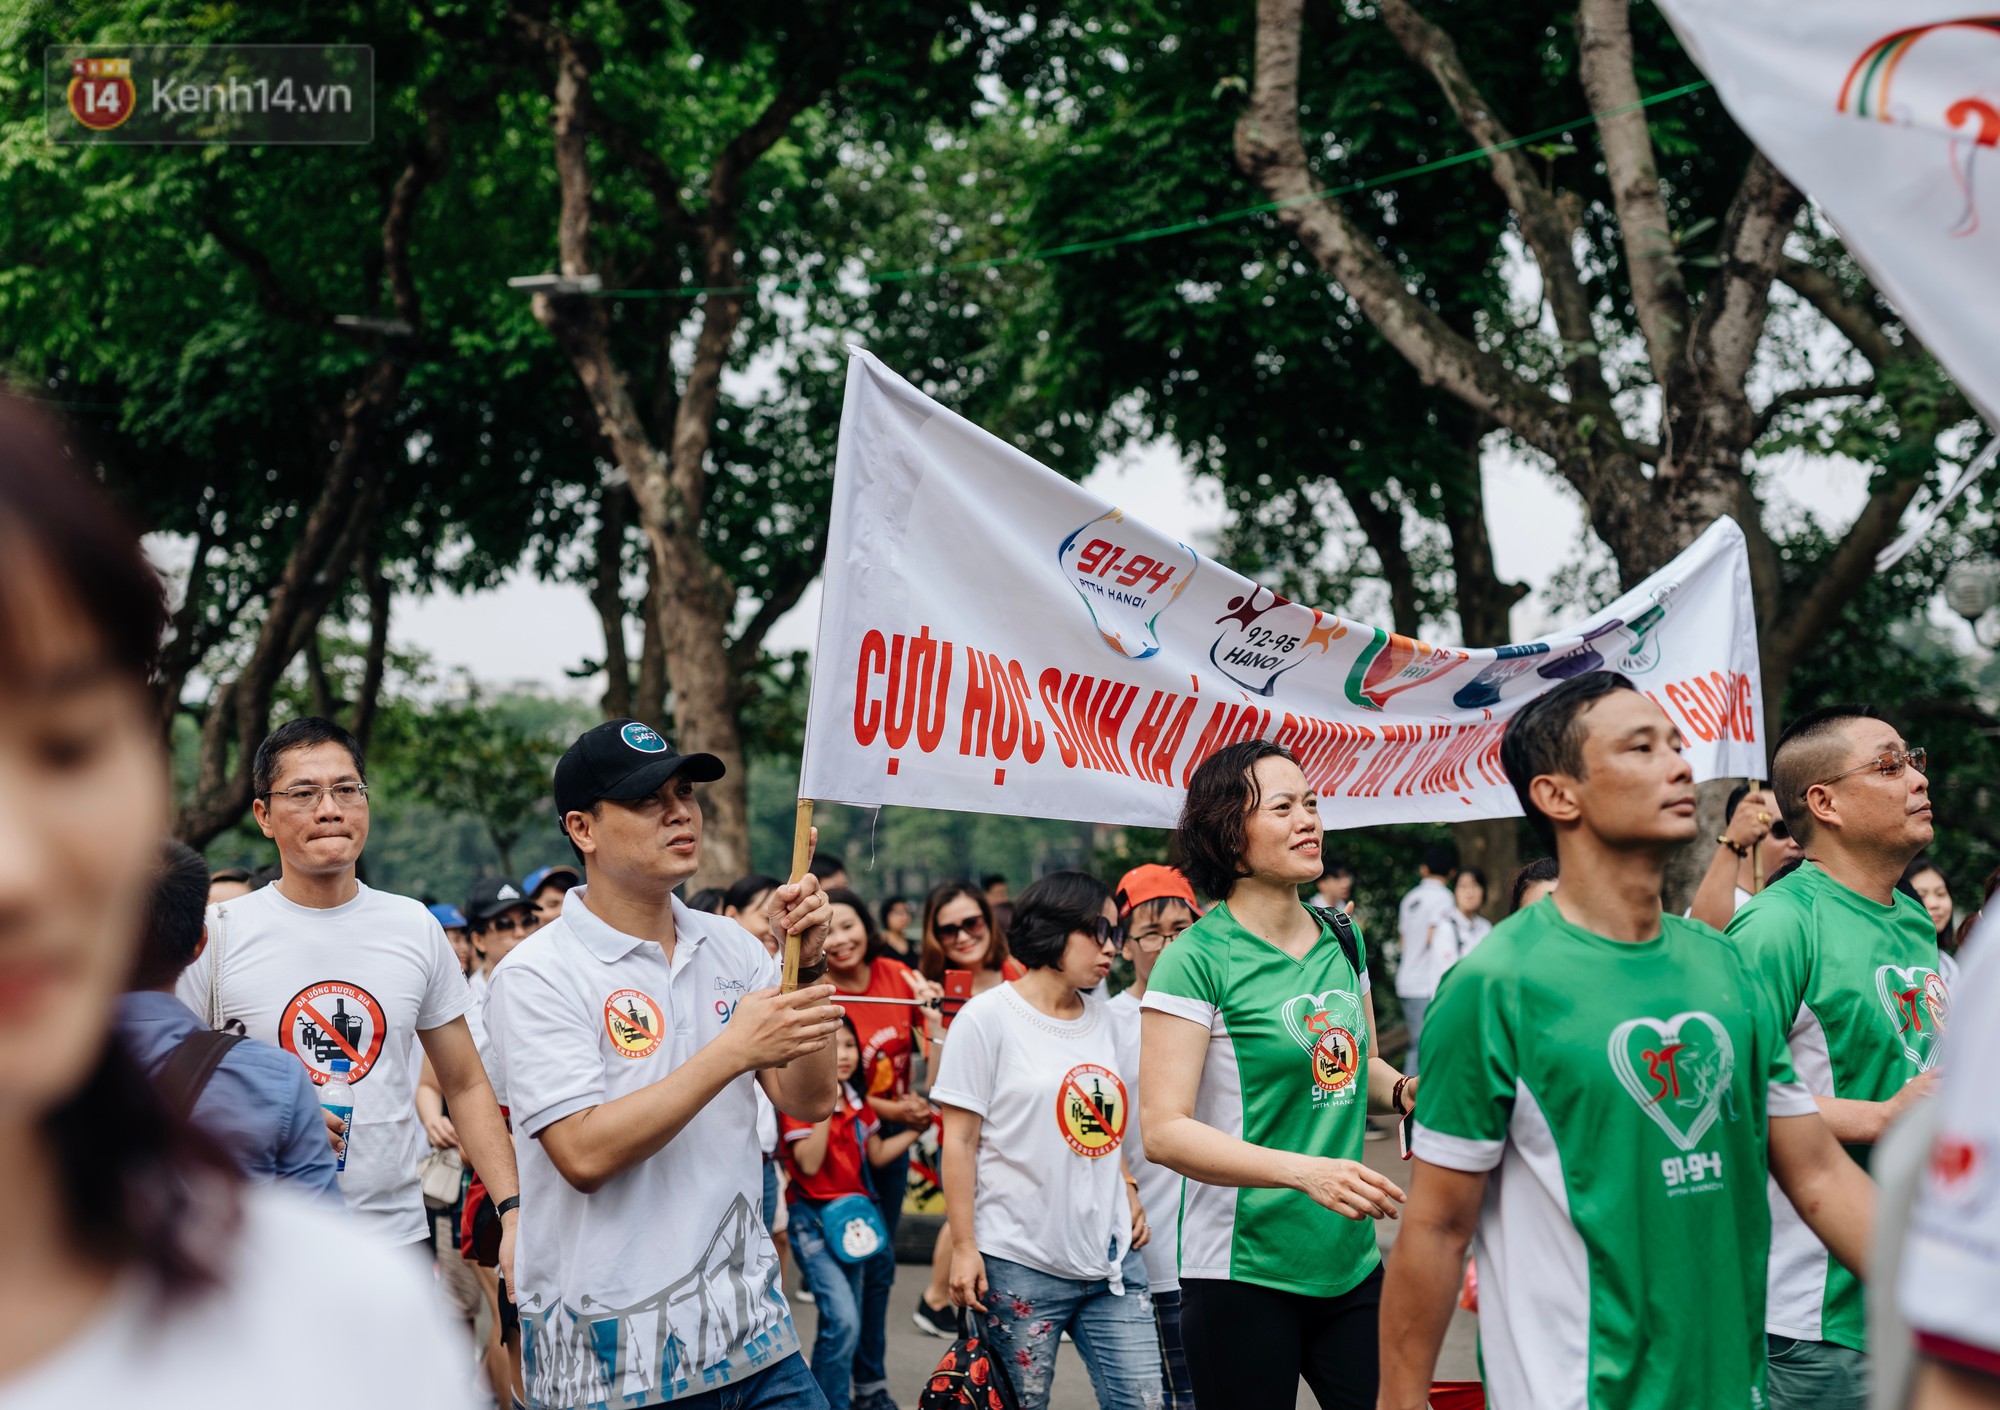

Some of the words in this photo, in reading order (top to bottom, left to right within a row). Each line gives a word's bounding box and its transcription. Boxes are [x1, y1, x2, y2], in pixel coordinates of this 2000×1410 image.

[1077, 539, 1176, 594] 91-94
[1079, 578, 1104, 595] PTTH
[1108, 588, 1147, 609] HANOI
[1246, 627, 1300, 653] 92-95
[1223, 647, 1285, 670] HANOI
[854, 625, 953, 776] CỰU
[959, 646, 1046, 786] HỌC
[1039, 667, 1140, 777] SINH
[1130, 674, 1200, 788] HÀ
[357, 994, 371, 1007] BIA
[358, 1060, 370, 1075] XE
[1661, 1151, 1722, 1187] 91-94
